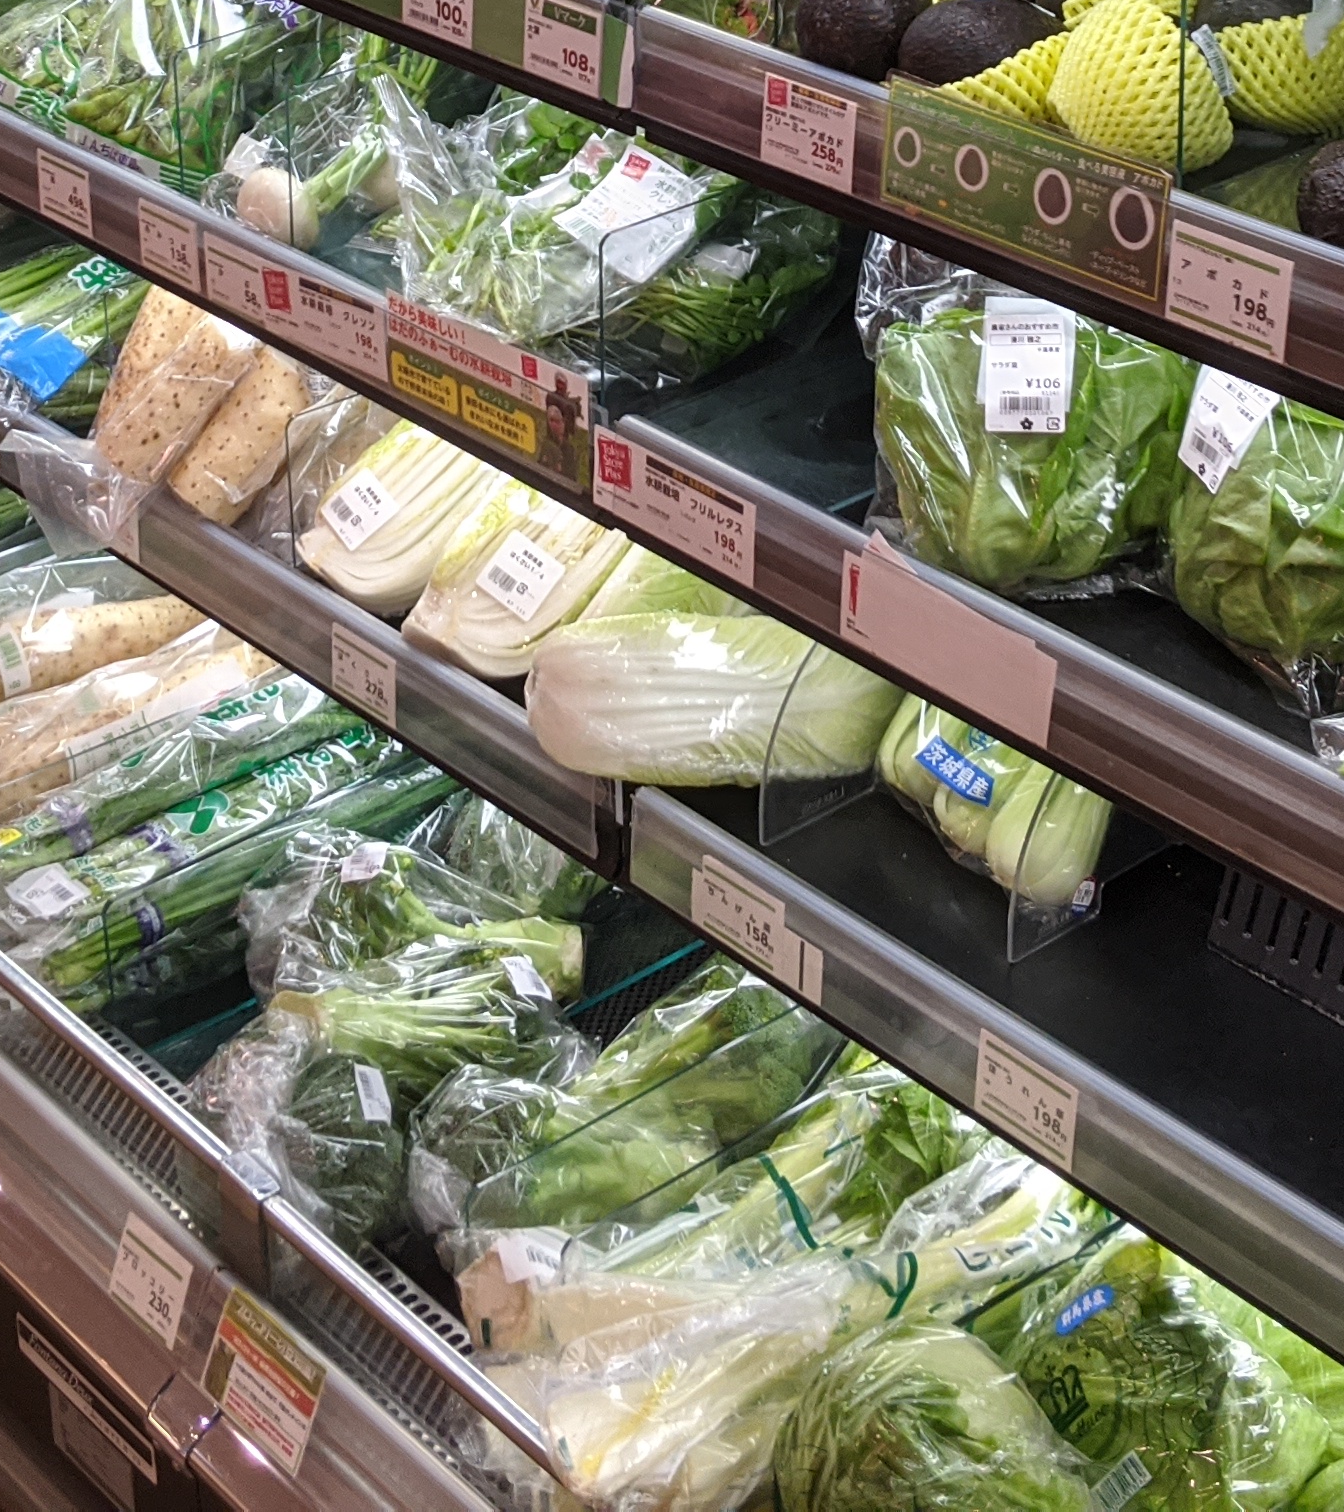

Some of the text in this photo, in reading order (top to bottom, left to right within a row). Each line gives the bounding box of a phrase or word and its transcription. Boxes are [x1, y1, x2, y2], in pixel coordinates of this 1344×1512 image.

[435, 0, 468, 29] 100円
[552, 6, 587, 27] Vマーク
[561, 46, 596, 76] 108円
[765, 112, 844, 148] クリーミーアボカド
[810, 141, 844, 168] 258円
[1179, 257, 1270, 300] アボカド
[387, 294, 467, 345] だから美味しい！
[1231, 292, 1275, 330] 198円
[1025, 377, 1061, 390] ¥106
[689, 498, 744, 536] フリルレタス
[713, 527, 744, 560] 198円
[922, 741, 992, 800] 茨城県産
[744, 920, 775, 954] 158円
[1032, 1105, 1067, 1143] 198円
